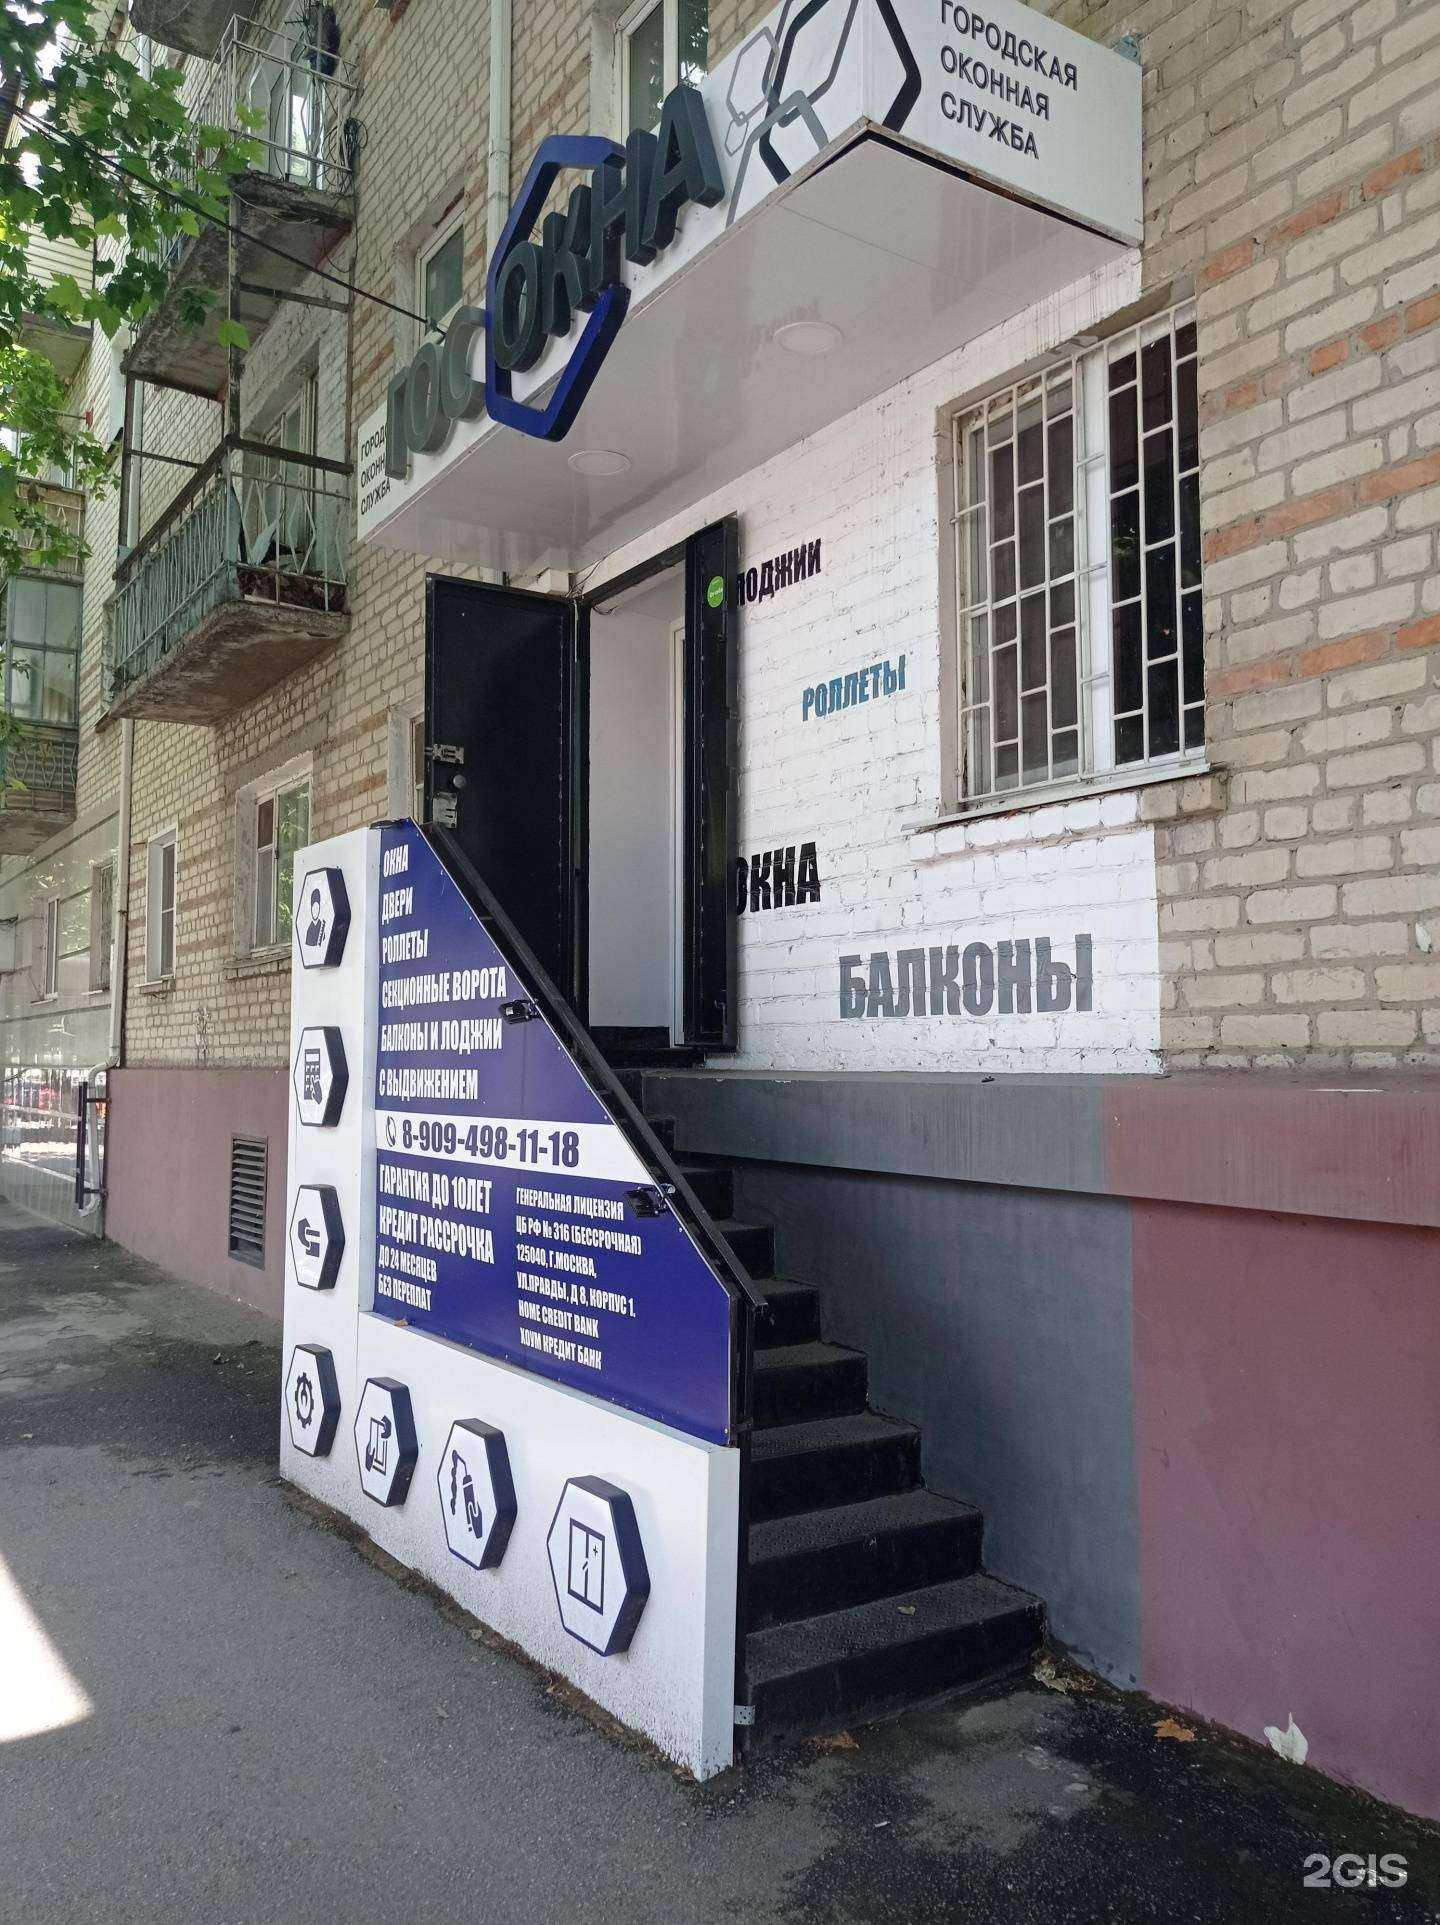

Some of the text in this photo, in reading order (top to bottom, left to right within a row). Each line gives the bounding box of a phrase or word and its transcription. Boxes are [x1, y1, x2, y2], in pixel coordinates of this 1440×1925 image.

[941, 0, 1078, 92] ГОРОДСКАЯ
[940, 45, 1050, 121] ОКОННАЯ
[940, 91, 1039, 160] СЛУЖБА
[360, 477, 391, 515] СЛУЖБА
[802, 654, 906, 722] РОЛЛЕТЫ
[383, 844, 409, 877] ОКНА
[381, 886, 413, 925] ДВЕРИ
[382, 929, 429, 964] РОЛЛЕТЫ
[382, 966, 507, 1010] СЕКЦИОННЫЕ ВОРОТА
[839, 933, 1093, 1019] БАЛКОНЫ
[381, 1018, 503, 1054] БАЛКОНЫ И ЛОДЖИИ
[379, 1068, 478, 1101] С ВЫДВИЖЕНИЕМ
[402, 1119, 580, 1168] 8-909-498-11-18
[379, 1164, 430, 1203] ГАРАНТИЯ
[432, 1173, 449, 1210] ДО
[516, 1187, 624, 1220] ГЕНЕРАЛЬНАЯ ЛИЦЕНЗИЯ
[380, 1205, 495, 1265] КРЕДИТ РАССРОЧКА
[516, 1215, 527, 1235] ЦБ
[528, 1218, 540, 1236] РФ
[554, 1222, 569, 1242] 316
[571, 1225, 641, 1256] (БЕССРОЧНАЯ)
[378, 1245, 437, 1282] ДО 24 МЕСЯЦЕВ
[516, 1243, 548, 1268] 125040,
[378, 1273, 431, 1312] БЕЗ ПЕРЕПЛАТ
[590, 1288, 627, 1315] КОРПУС
[518, 1299, 599, 1338] HOME CREDIT BANK
[520, 1327, 602, 1371] ХОУМ КРЕДИТ БАНК
